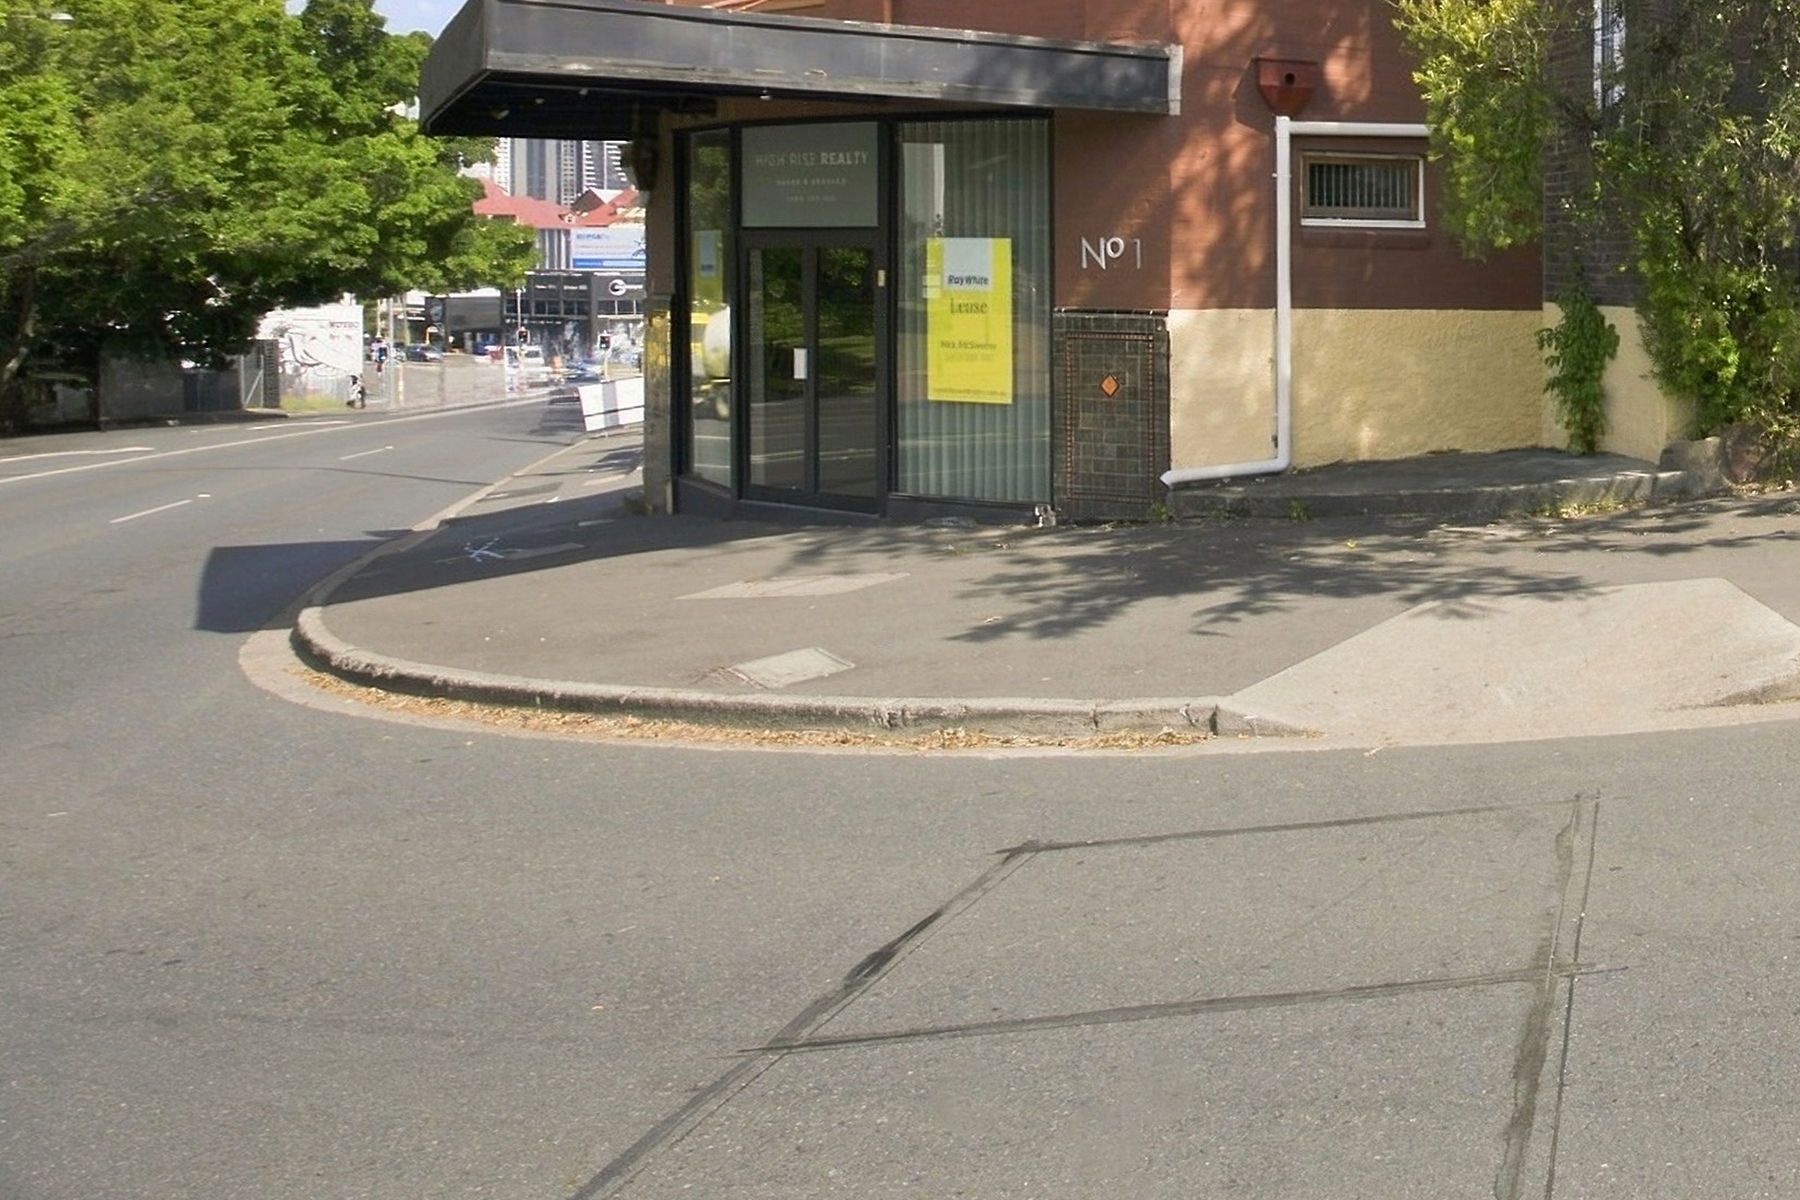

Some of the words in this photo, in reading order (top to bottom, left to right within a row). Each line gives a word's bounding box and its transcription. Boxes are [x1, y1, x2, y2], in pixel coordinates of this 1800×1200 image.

[756, 153, 785, 167] HIGH
[789, 152, 817, 166] RISE
[820, 151, 869, 165] REALTY
[1133, 238, 1142, 270] 1
